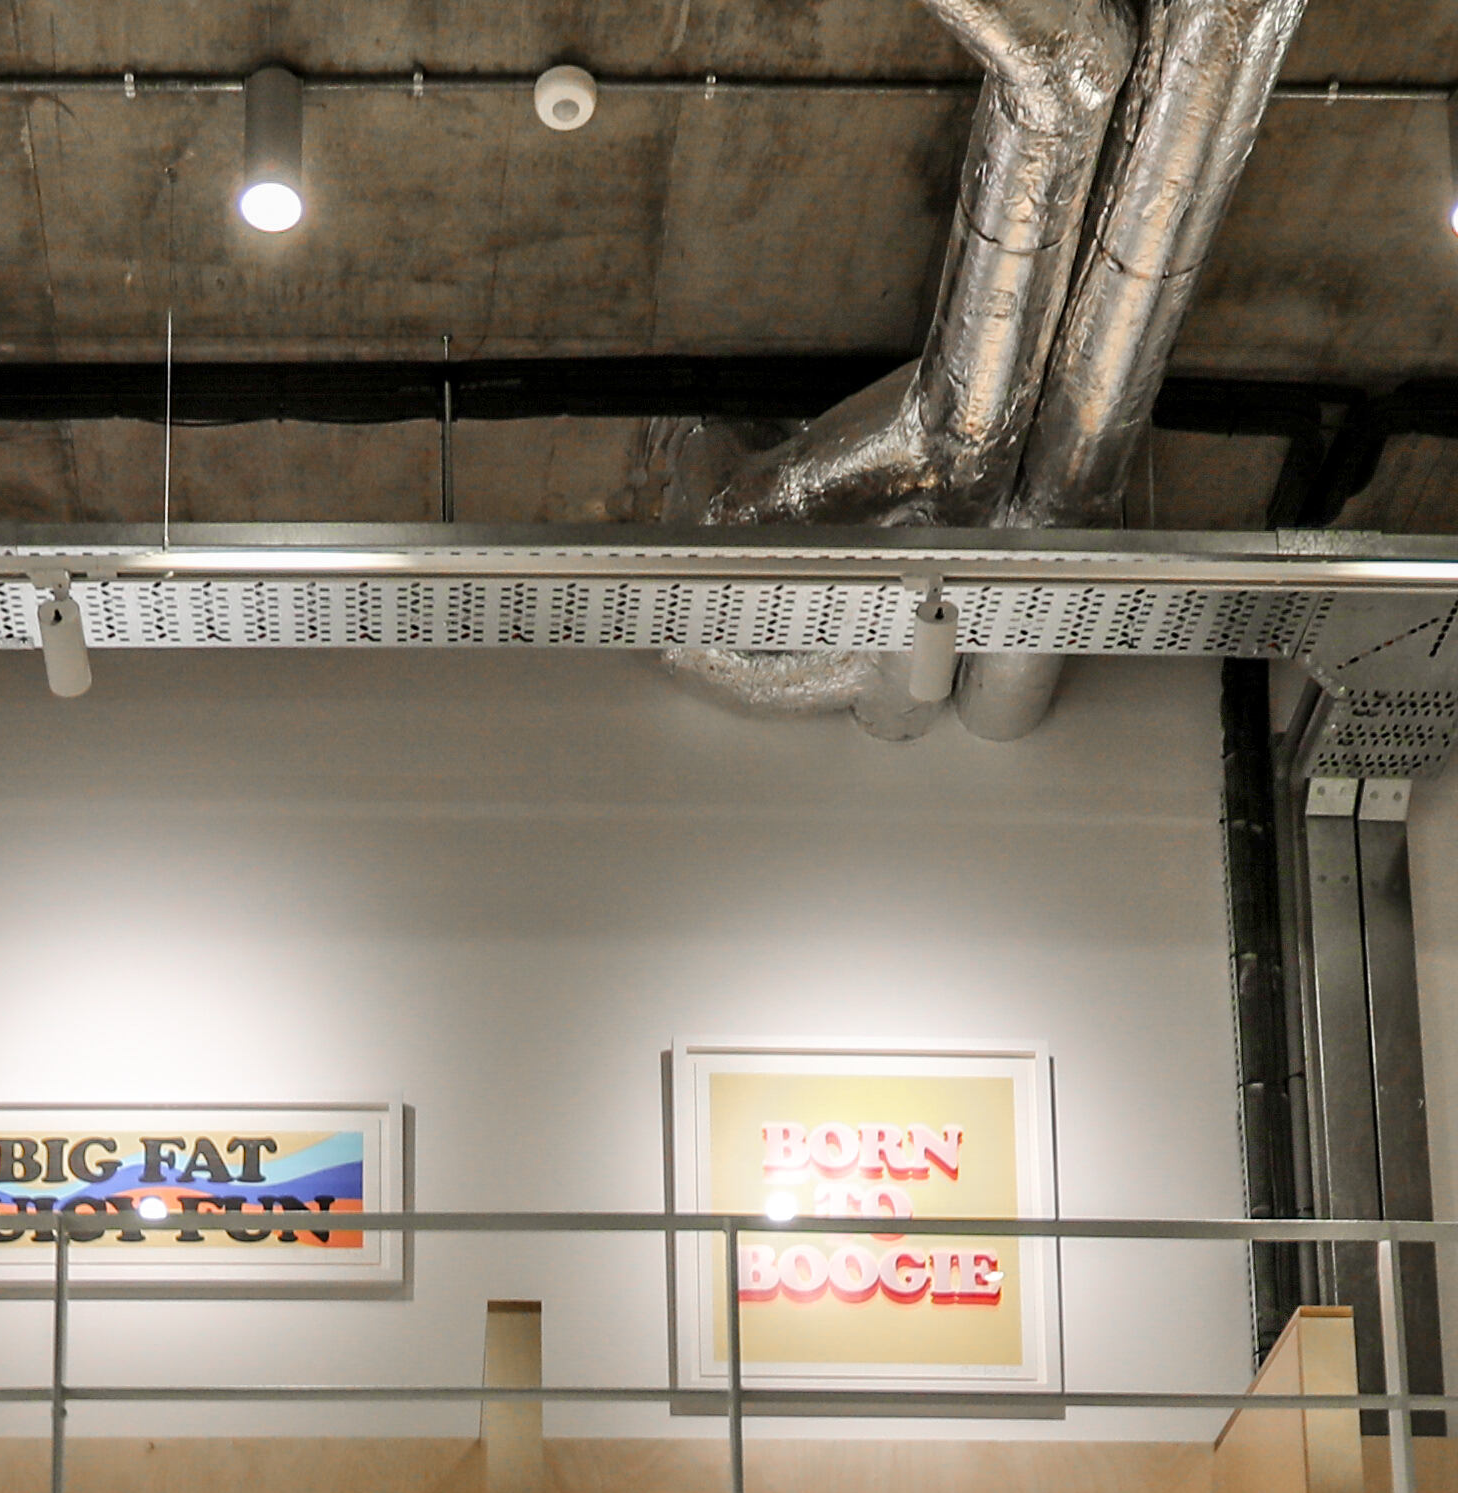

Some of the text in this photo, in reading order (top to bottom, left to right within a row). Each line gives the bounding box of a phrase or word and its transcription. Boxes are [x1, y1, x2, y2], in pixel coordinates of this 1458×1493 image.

[138, 1136, 278, 1184] FAT
[761, 1121, 963, 1181] BORN
[816, 1185, 913, 1244] TO
[737, 1244, 1002, 1306] BOOGIE
